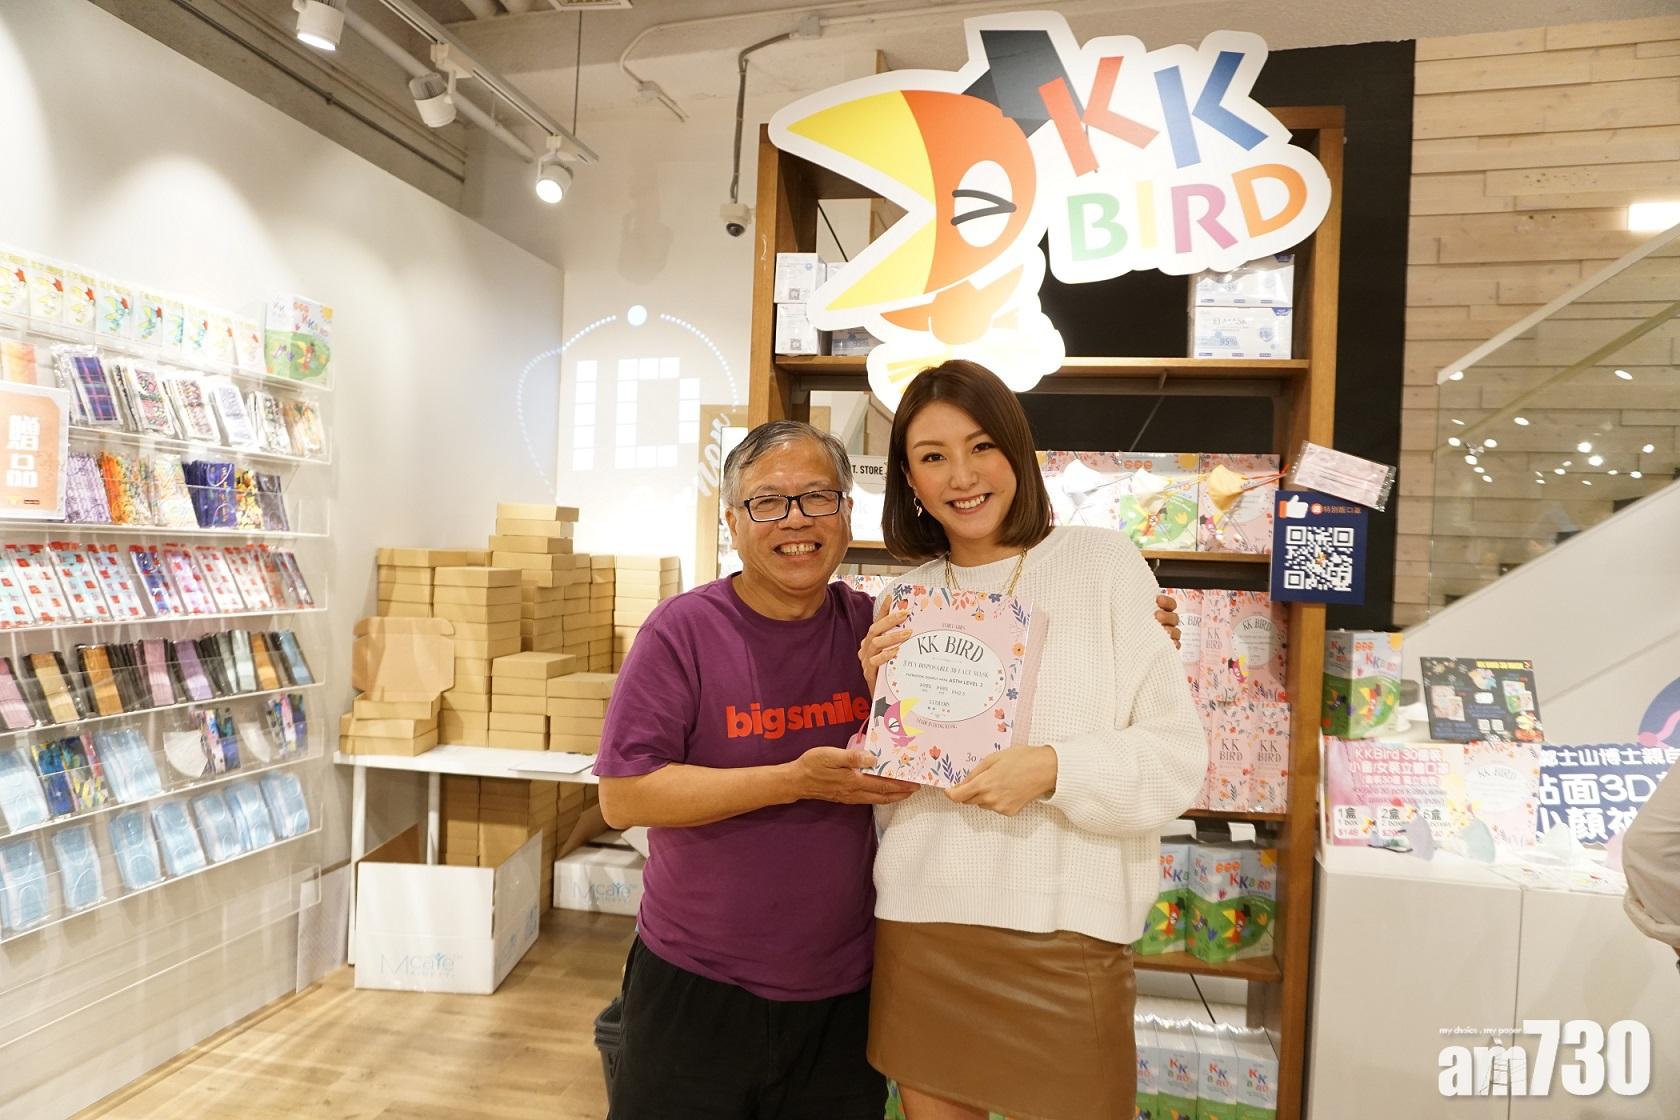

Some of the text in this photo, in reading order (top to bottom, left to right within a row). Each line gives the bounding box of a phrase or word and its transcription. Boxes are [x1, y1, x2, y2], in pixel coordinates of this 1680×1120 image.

[1038, 50, 1269, 177] KK
[1066, 163, 1308, 262] BIRD
[860, 465, 884, 476] STORE
[916, 634, 985, 663] KK BIRD
[1221, 738, 1241, 752] KK
[1260, 739, 1279, 753] KK
[1219, 751, 1243, 761] BIRD
[1257, 751, 1282, 763] BIRD
